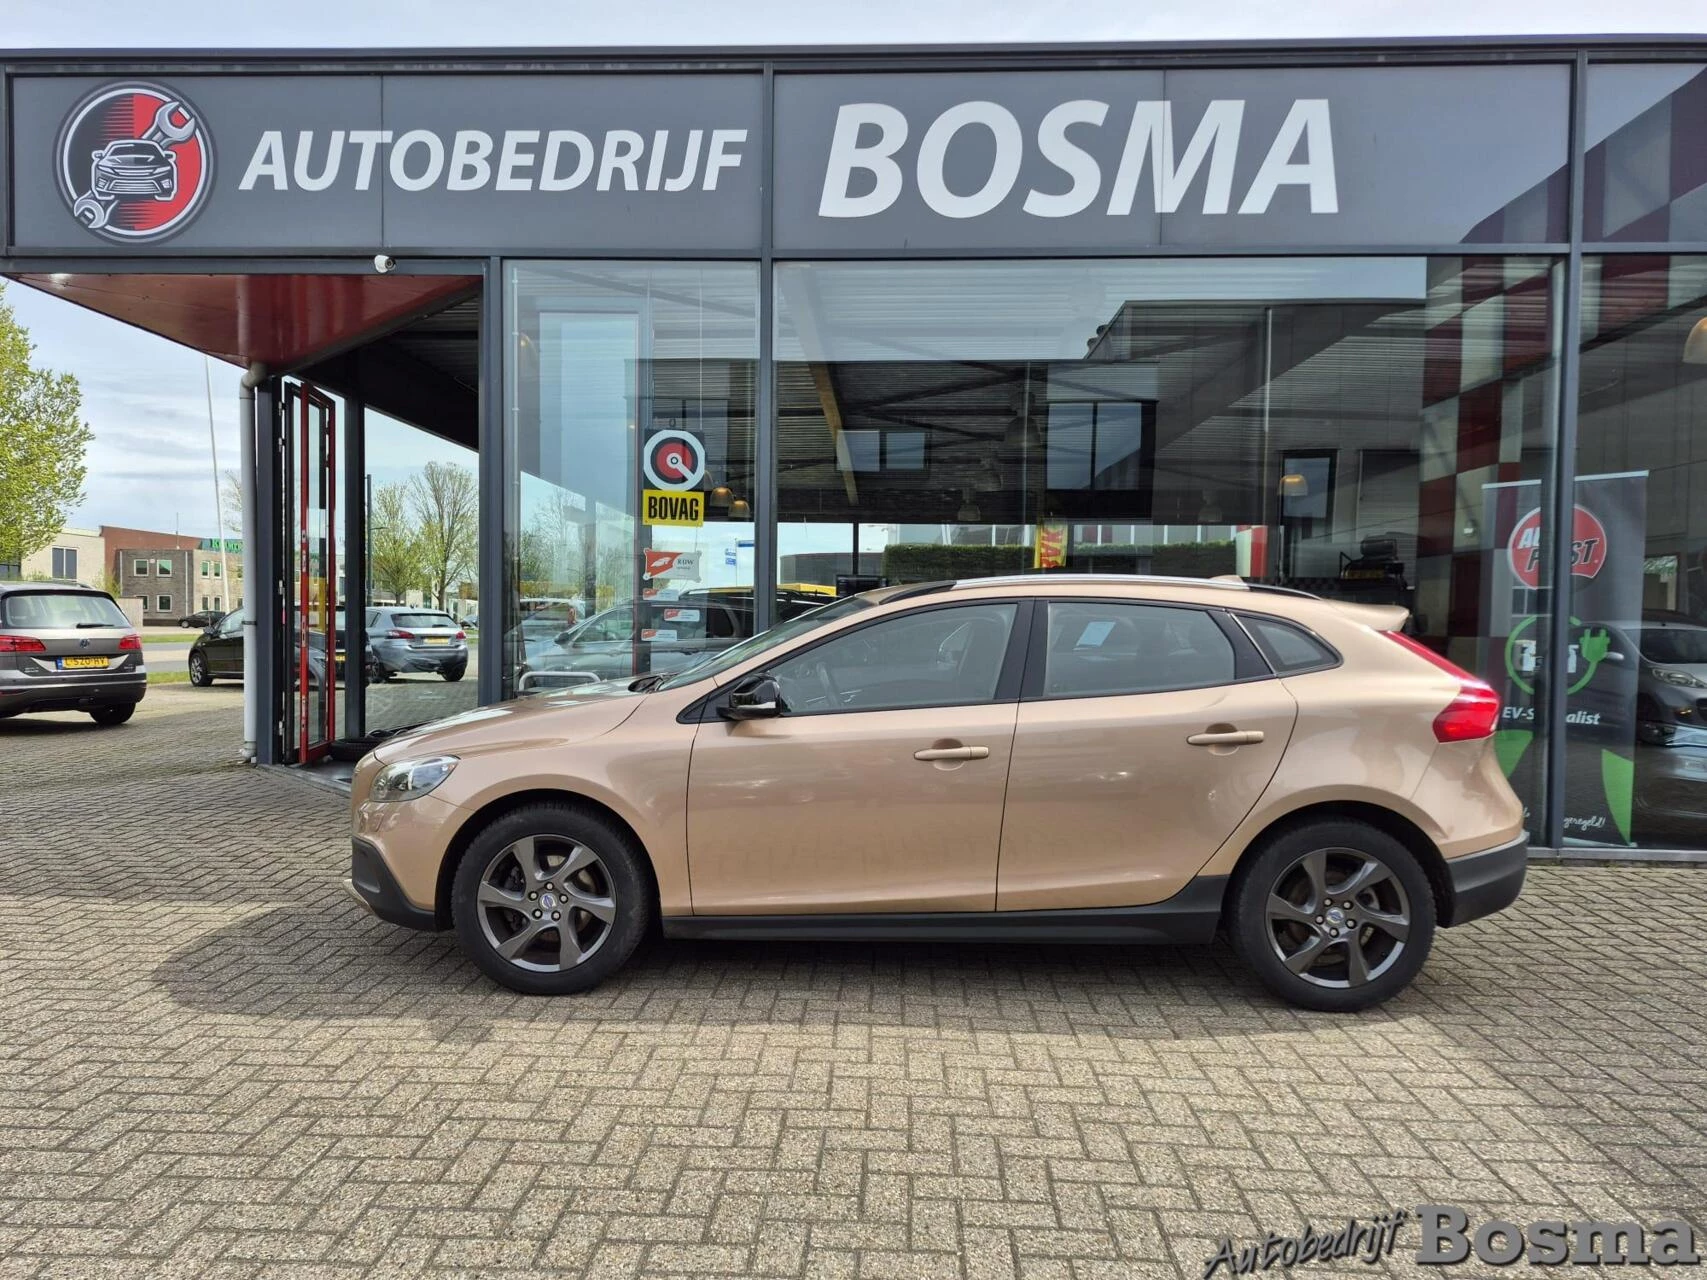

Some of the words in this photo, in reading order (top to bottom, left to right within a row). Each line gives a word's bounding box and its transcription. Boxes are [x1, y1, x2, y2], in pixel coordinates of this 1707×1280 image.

[238, 128, 749, 193] AUTOBEDRIJF
[818, 98, 1339, 219] BOSMA
[647, 495, 700, 522] BOVAG
